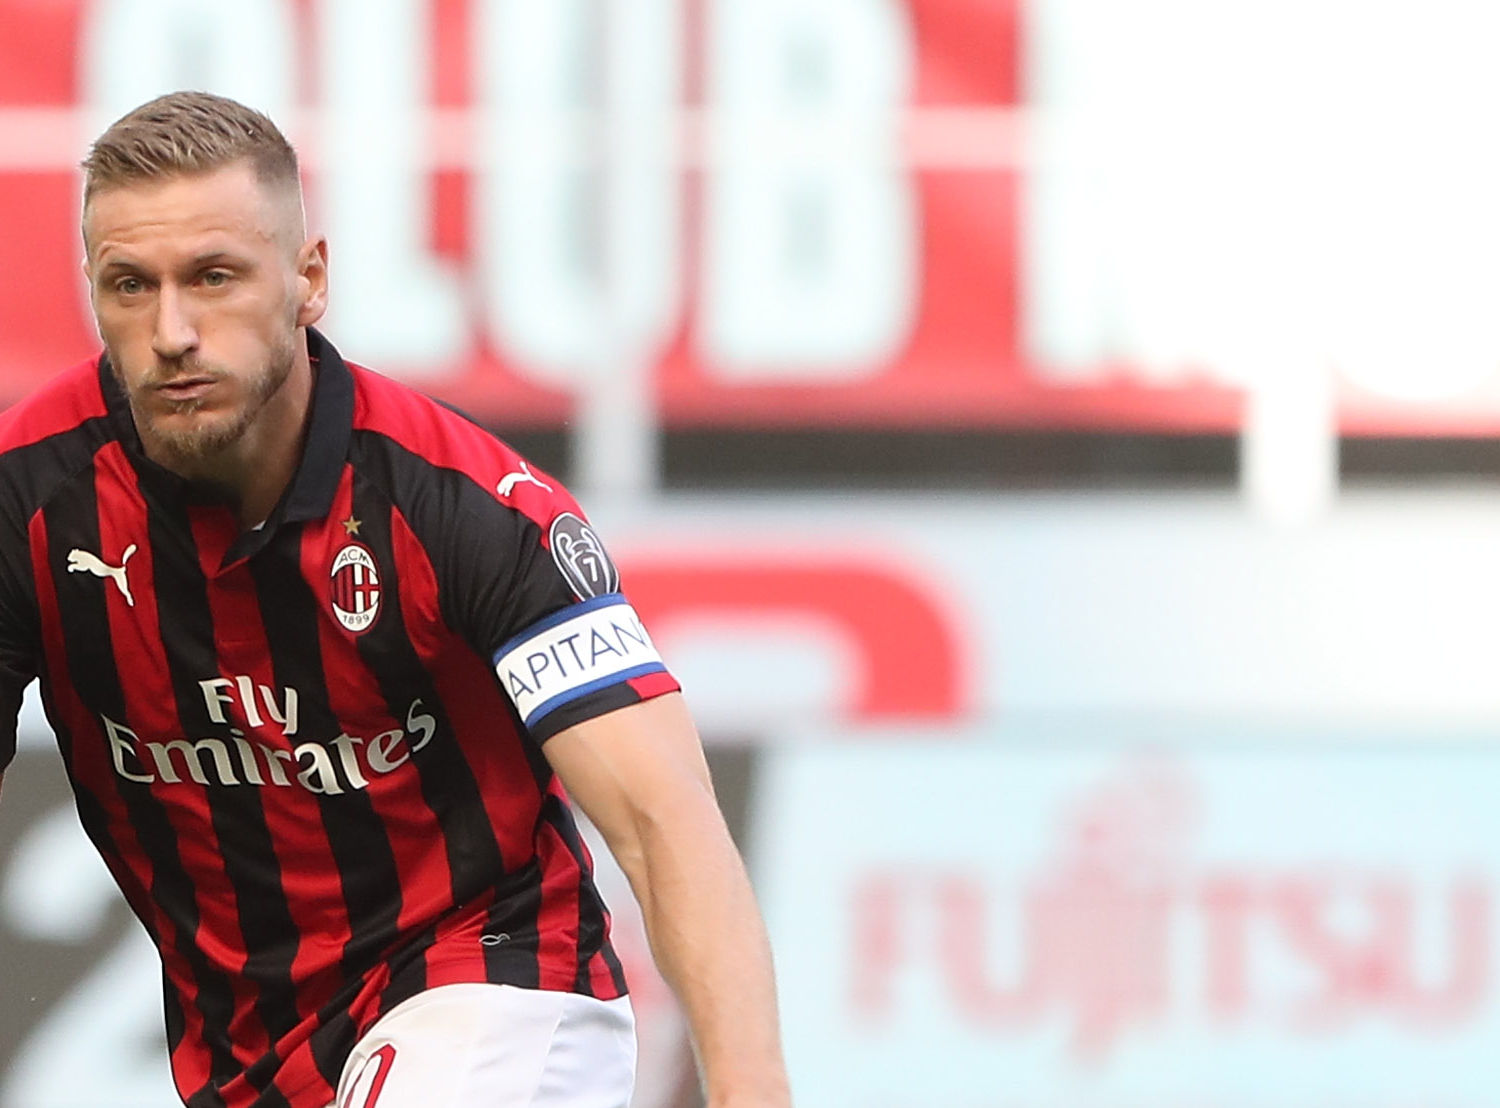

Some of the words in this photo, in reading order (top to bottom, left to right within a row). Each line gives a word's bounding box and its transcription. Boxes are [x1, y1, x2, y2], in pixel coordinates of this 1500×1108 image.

[88, 0, 918, 385] LUB
[338, 548, 370, 566] ACM
[583, 556, 598, 582] 7
[343, 614, 370, 625] 1899
[200, 675, 299, 735] Fly
[101, 698, 437, 796] Emirates
[850, 860, 1492, 1070] FUJITSU
